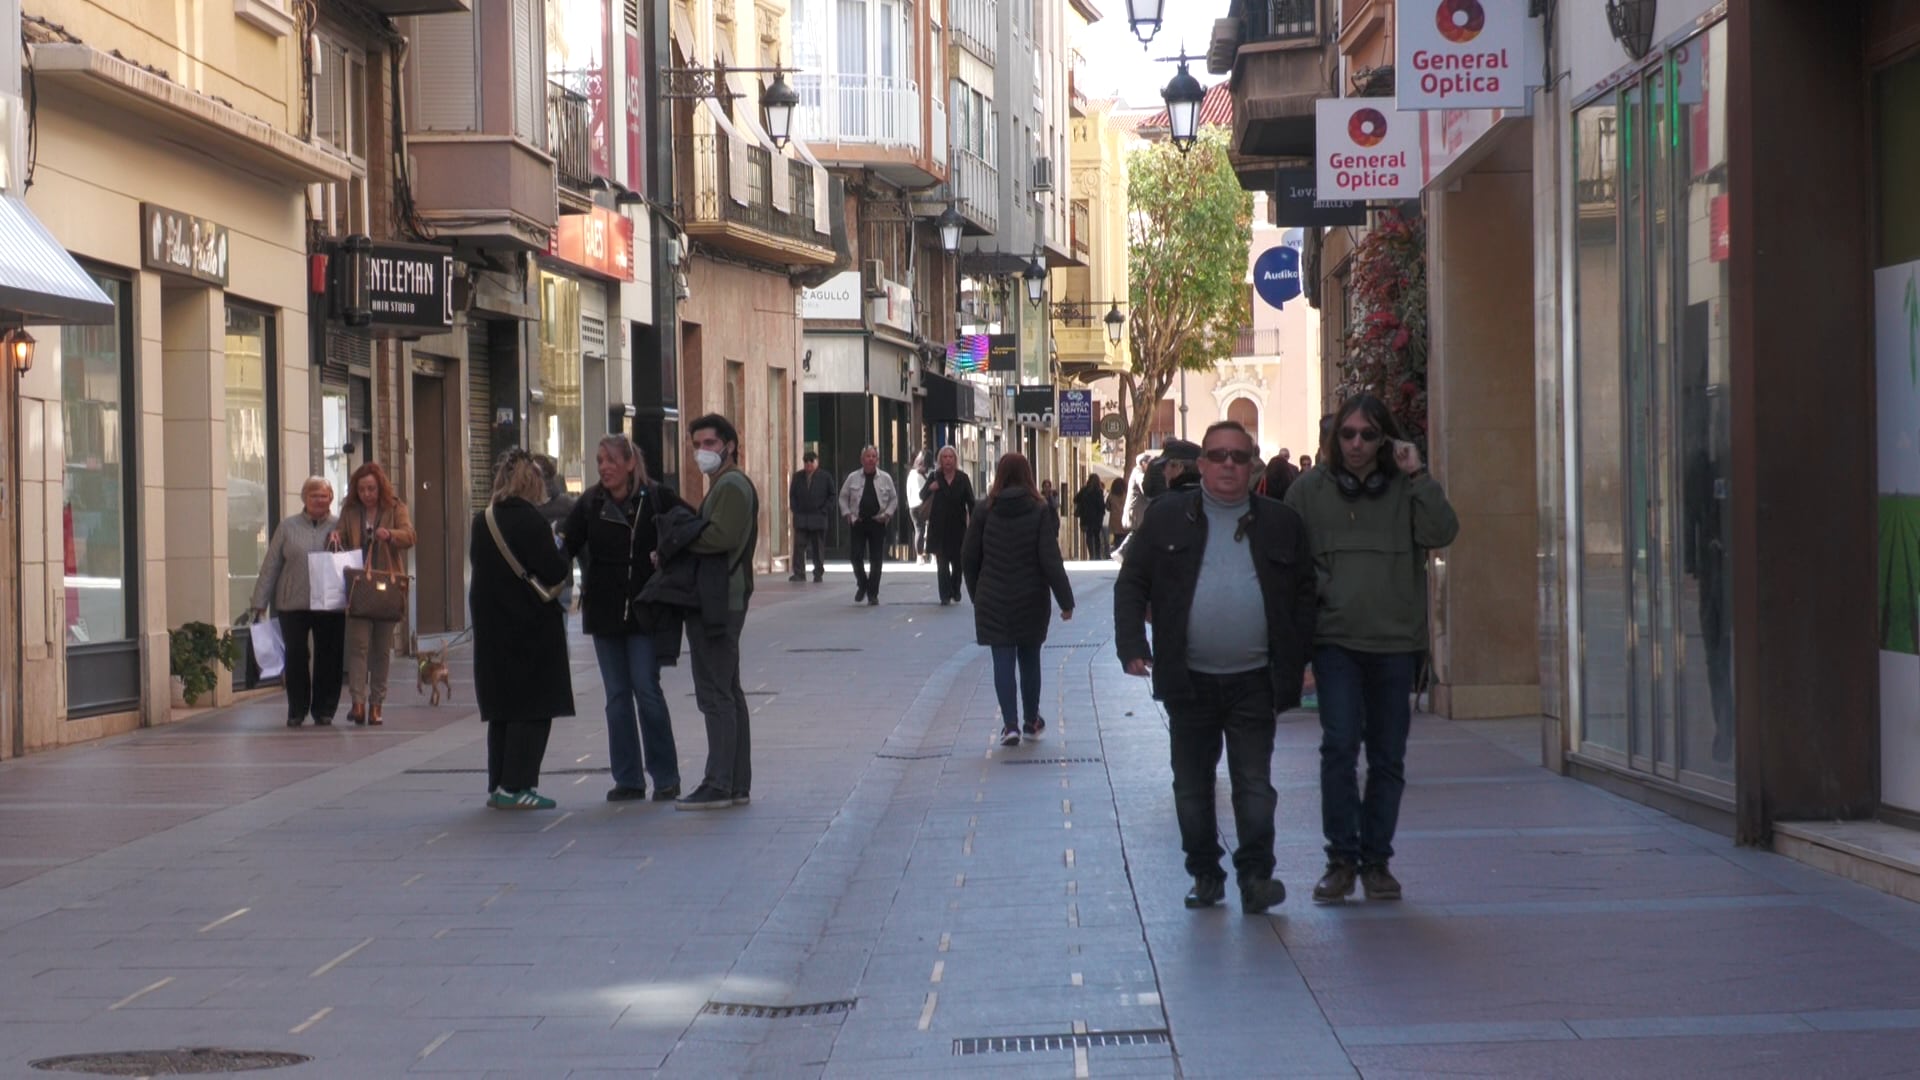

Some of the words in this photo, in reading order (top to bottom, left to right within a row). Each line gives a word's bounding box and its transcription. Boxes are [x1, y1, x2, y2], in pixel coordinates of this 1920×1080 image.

[1413, 48, 1508, 70] General
[1420, 73, 1500, 98] Optica
[1329, 151, 1406, 169] General
[1336, 170, 1399, 191] Optica
[584, 215, 604, 260] GAES
[366, 257, 434, 295] NTLEMAN
[810, 289, 850, 301] AGULLÓ
[371, 299, 389, 313] HAIR
[390, 301, 415, 314] STUDIO
